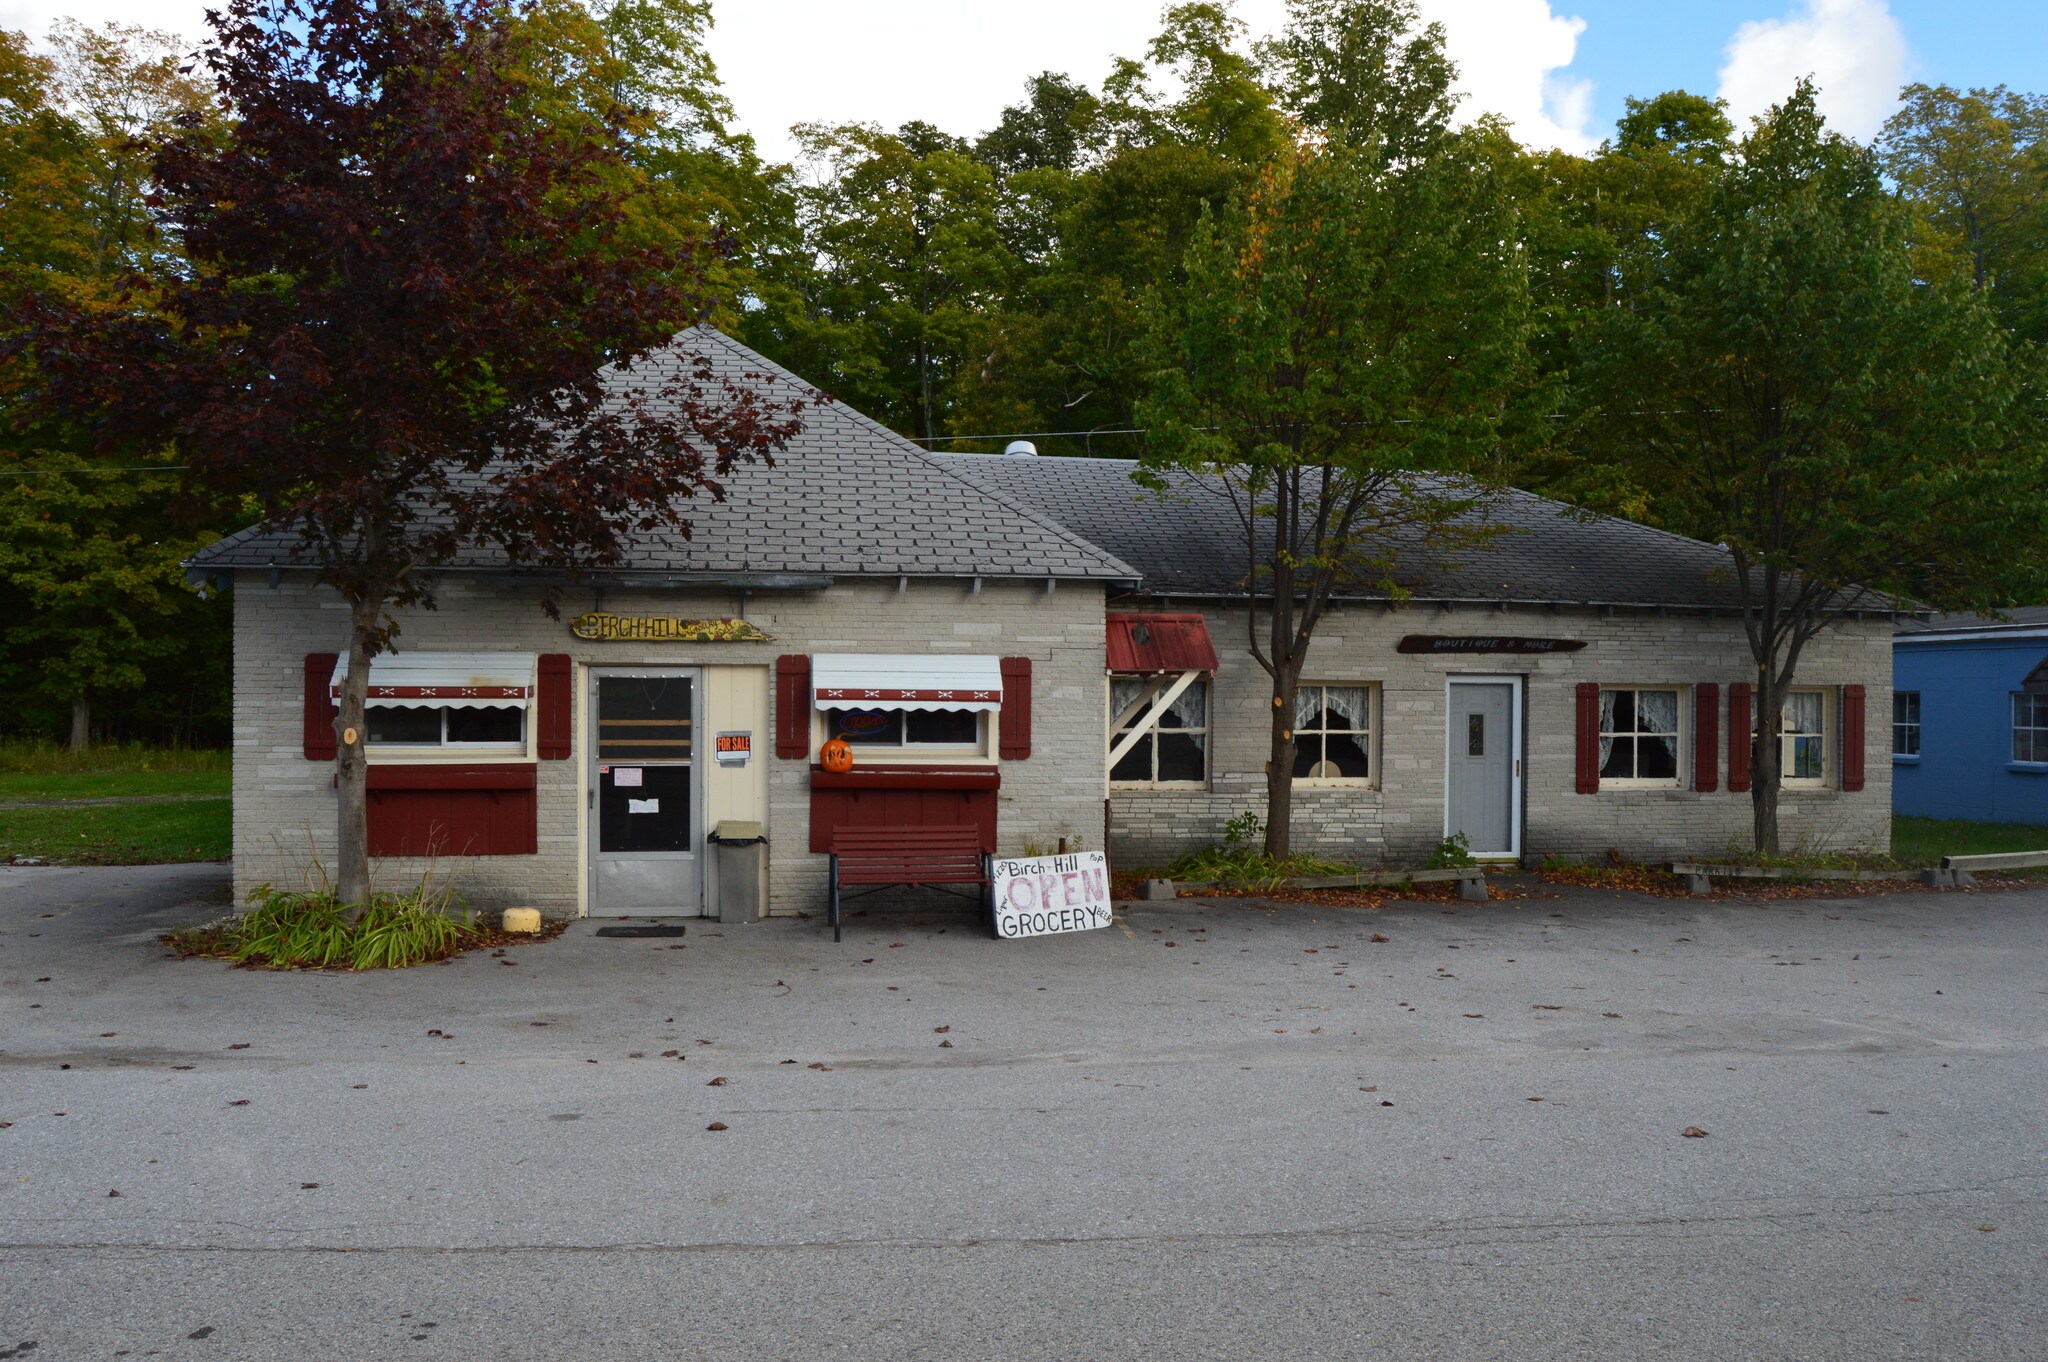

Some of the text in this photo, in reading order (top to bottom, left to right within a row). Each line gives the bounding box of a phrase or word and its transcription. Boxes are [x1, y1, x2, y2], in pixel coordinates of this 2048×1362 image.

[587, 614, 687, 638] BIRCH HILL
[1433, 639, 1556, 650] BOUTIQUE & MORE
[717, 736, 750, 751] FOR SALE
[1008, 855, 1078, 877] Birch Hill
[1007, 868, 1104, 912] OPEN
[1002, 905, 1098, 937] GROCERY
[1097, 907, 1112, 924] BEER
